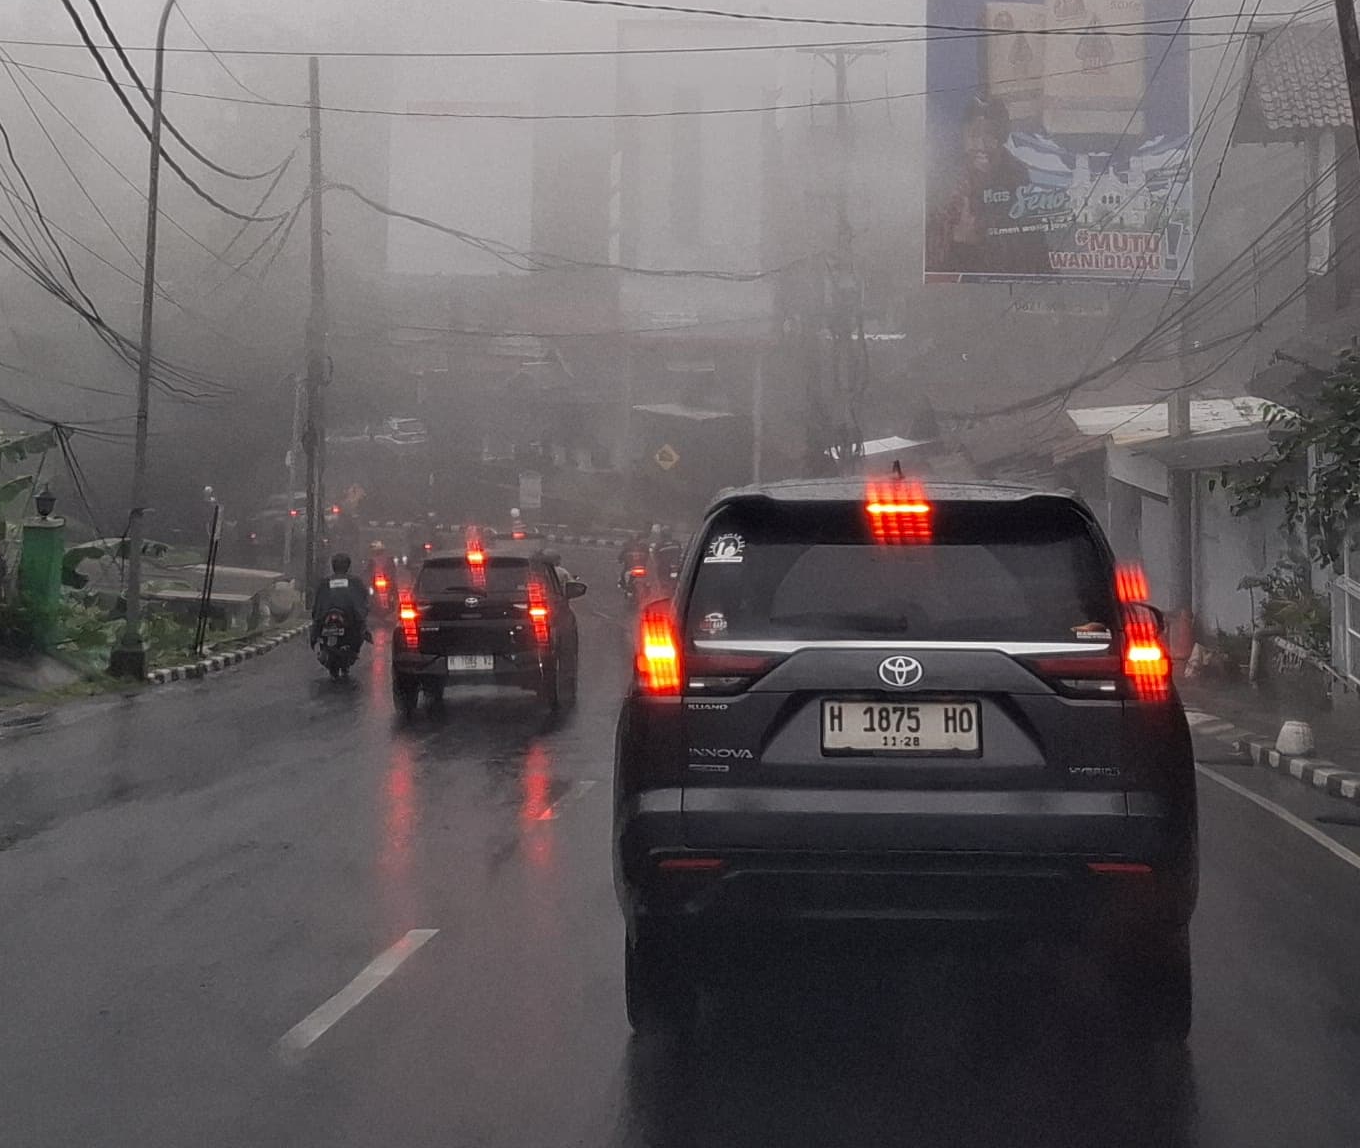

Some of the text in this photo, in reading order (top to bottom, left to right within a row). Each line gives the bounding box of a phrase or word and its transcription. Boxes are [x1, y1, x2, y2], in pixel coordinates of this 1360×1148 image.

[829, 705, 843, 732] H
[862, 706, 921, 733] 1875
[688, 747, 754, 759] INNOVA
